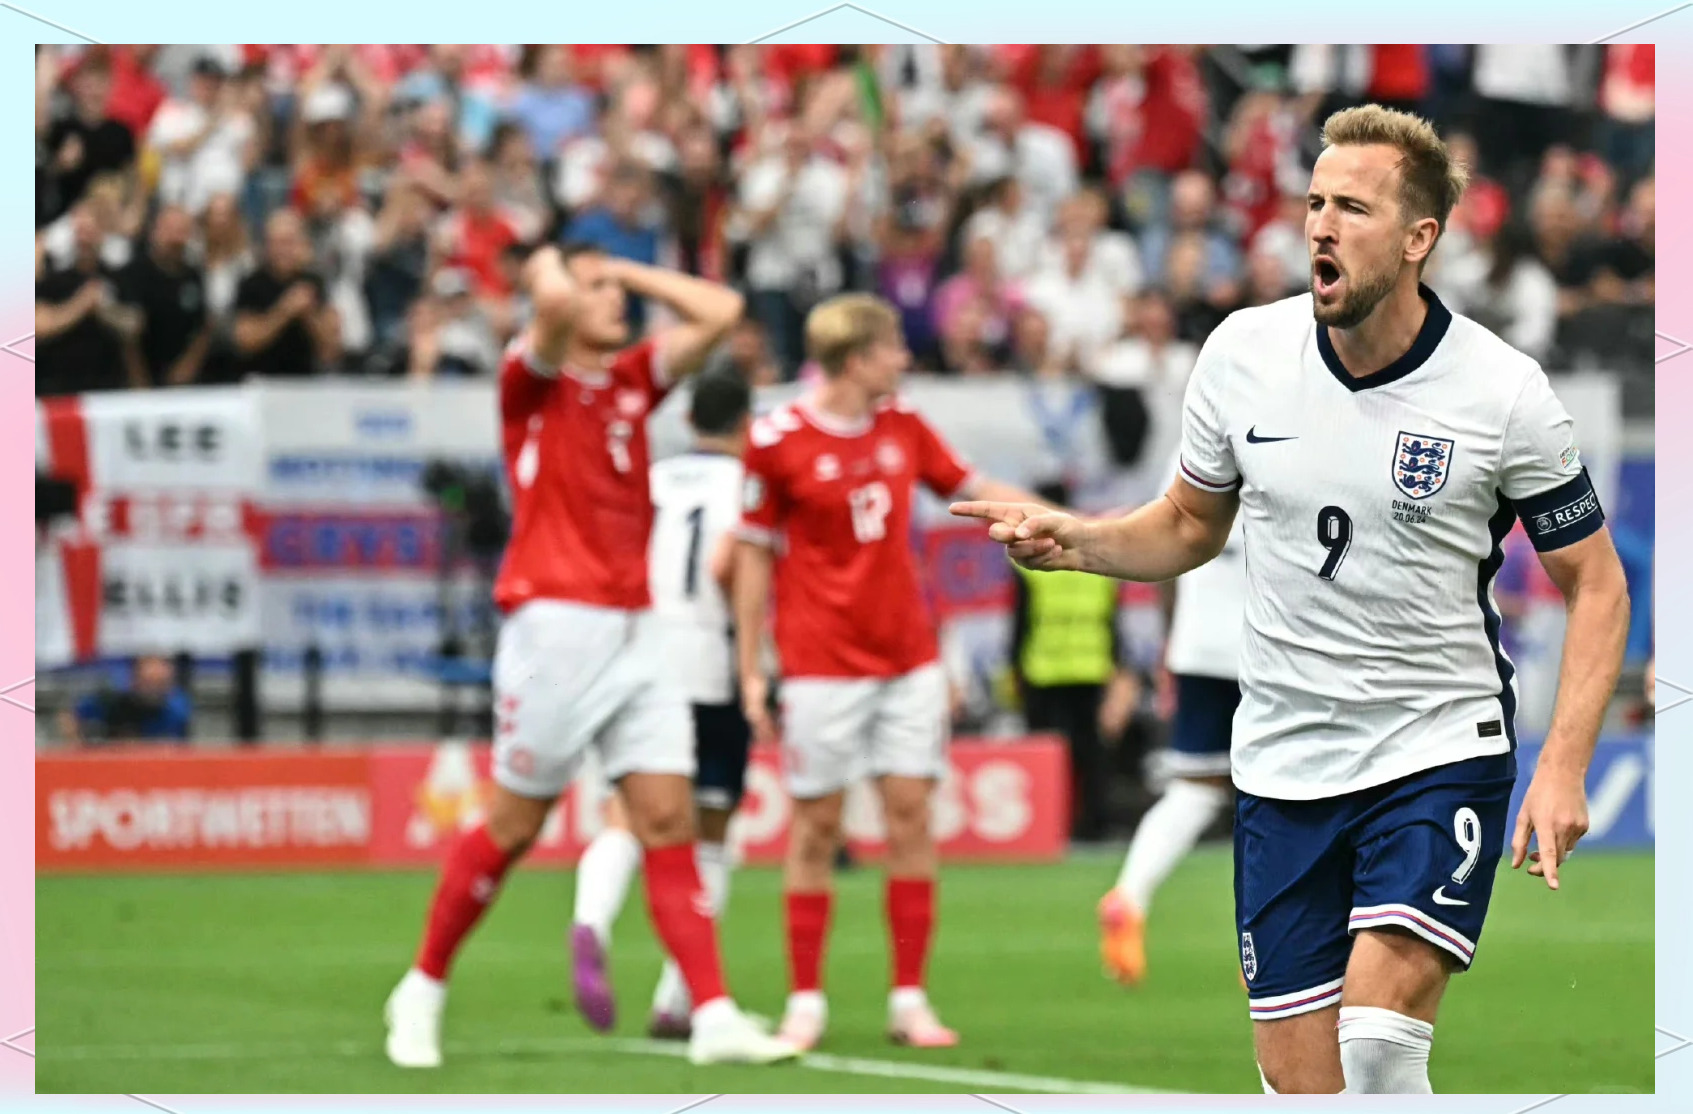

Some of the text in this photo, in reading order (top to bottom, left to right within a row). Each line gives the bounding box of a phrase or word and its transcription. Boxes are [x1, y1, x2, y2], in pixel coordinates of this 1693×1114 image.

[1391, 499, 1432, 515] DENMARK
[1393, 511, 1426, 523] 20.06.24
[1555, 492, 1596, 524] RESPEC
[1317, 505, 1353, 581] 9
[49, 786, 371, 849] SPORTWETTEN
[1451, 806, 1482, 885] 9
